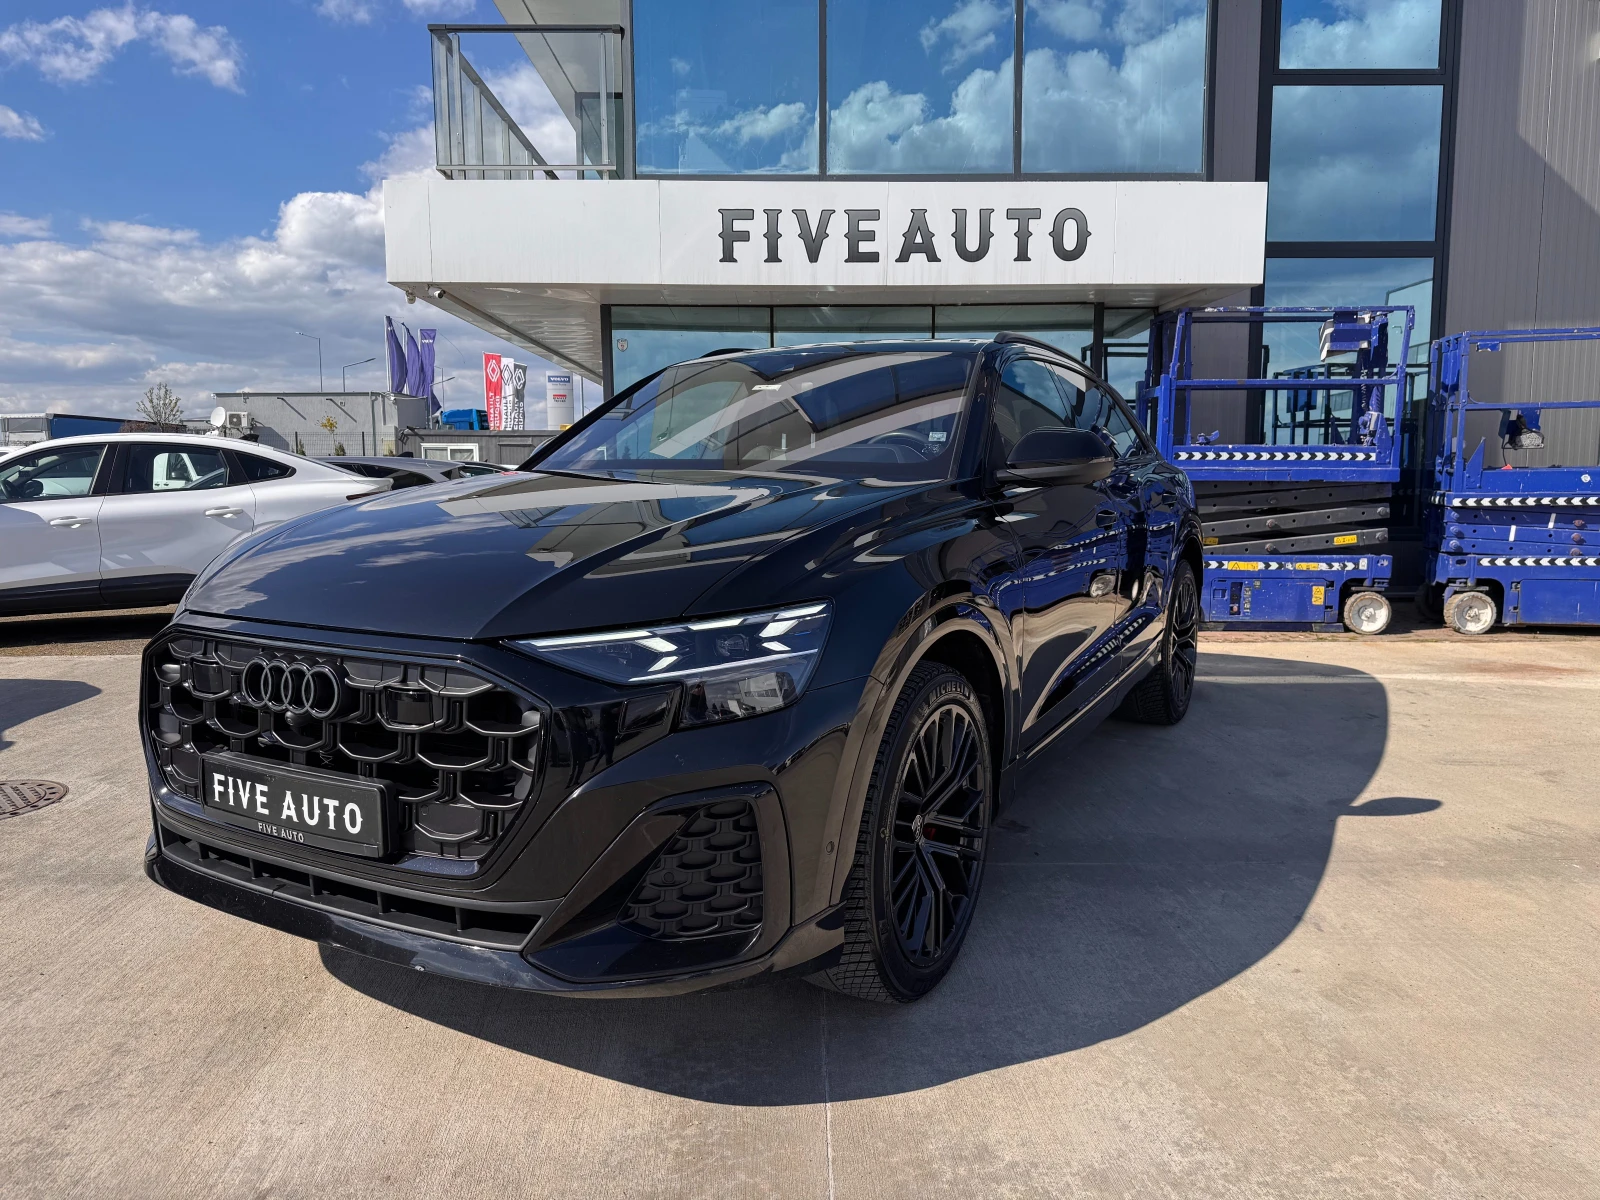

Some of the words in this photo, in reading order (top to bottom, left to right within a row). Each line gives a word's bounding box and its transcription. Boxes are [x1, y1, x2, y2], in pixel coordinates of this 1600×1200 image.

[928, 680, 970, 706] MICHELIN
[213, 772, 269, 815] FIVE
[280, 790, 363, 834] AUTO
[258, 822, 278, 836] FIVE
[281, 828, 304, 843] AUTO
